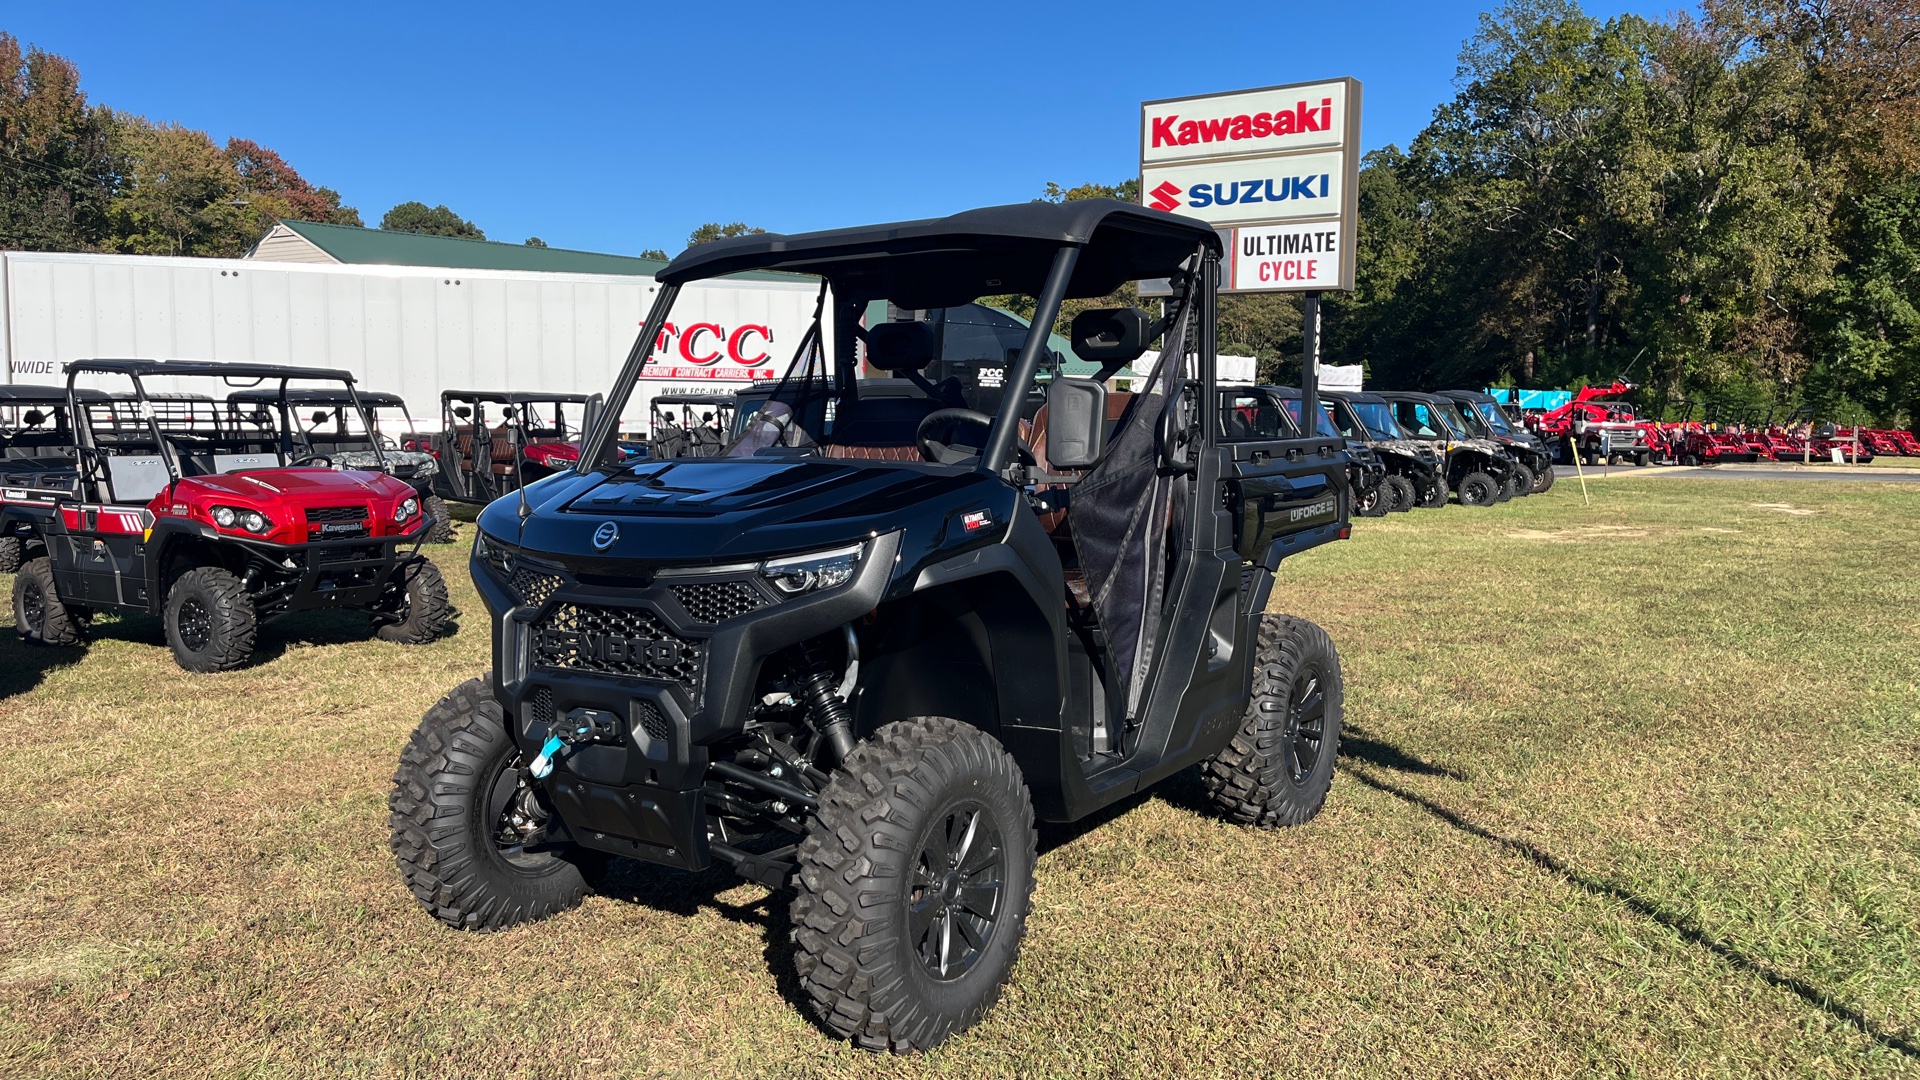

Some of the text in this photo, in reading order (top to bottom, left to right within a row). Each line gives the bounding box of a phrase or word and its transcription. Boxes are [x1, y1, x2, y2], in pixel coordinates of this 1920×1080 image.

[1152, 98, 1332, 148] Kawasaki
[1188, 174, 1329, 208] SUZUKI
[1243, 232, 1336, 257] ULTIMATE
[1259, 260, 1318, 282] CYCLE
[641, 366, 675, 377] REMONT
[675, 367, 714, 378] CONTRACT
[752, 369, 768, 379] INC.
[978, 368, 1003, 377] FCC
[321, 522, 363, 532] Kawasaki
